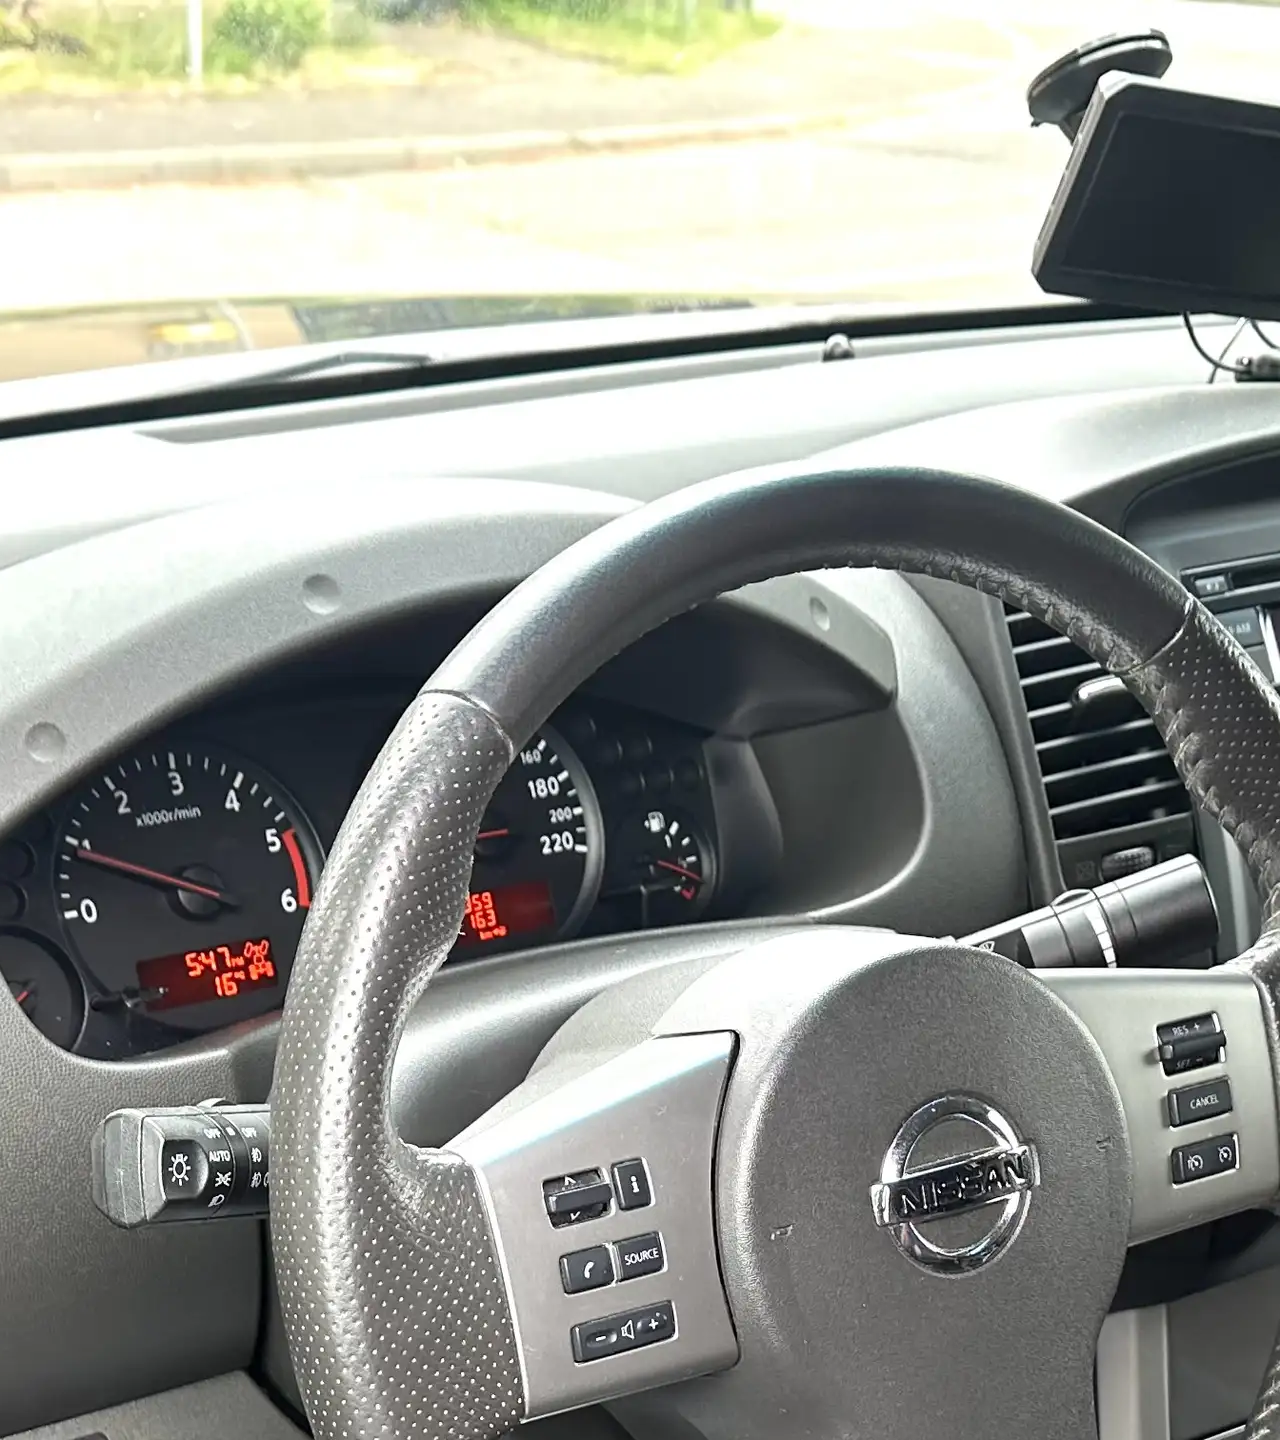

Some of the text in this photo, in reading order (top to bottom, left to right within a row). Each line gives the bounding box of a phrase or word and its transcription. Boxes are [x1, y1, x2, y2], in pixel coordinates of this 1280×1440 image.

[520, 750, 541, 765] 160
[168, 772, 184, 795] 3
[527, 776, 560, 799] 180
[115, 791, 131, 814] 2
[224, 789, 240, 812] 4
[549, 806, 573, 824] 200
[265, 828, 281, 852] 5
[539, 831, 574, 855] 220
[79, 899, 97, 923] 0
[280, 888, 297, 912] 6
[470, 909, 497, 929] 163
[184, 946, 232, 977] 5:47
[214, 972, 238, 996] 16
[1171, 1025, 1189, 1037] RES
[1189, 1093, 1220, 1110] CANCEL
[209, 1150, 231, 1162] AUTO
[894, 1147, 1028, 1217] NISSAN
[624, 1248, 659, 1266] SOURCE
